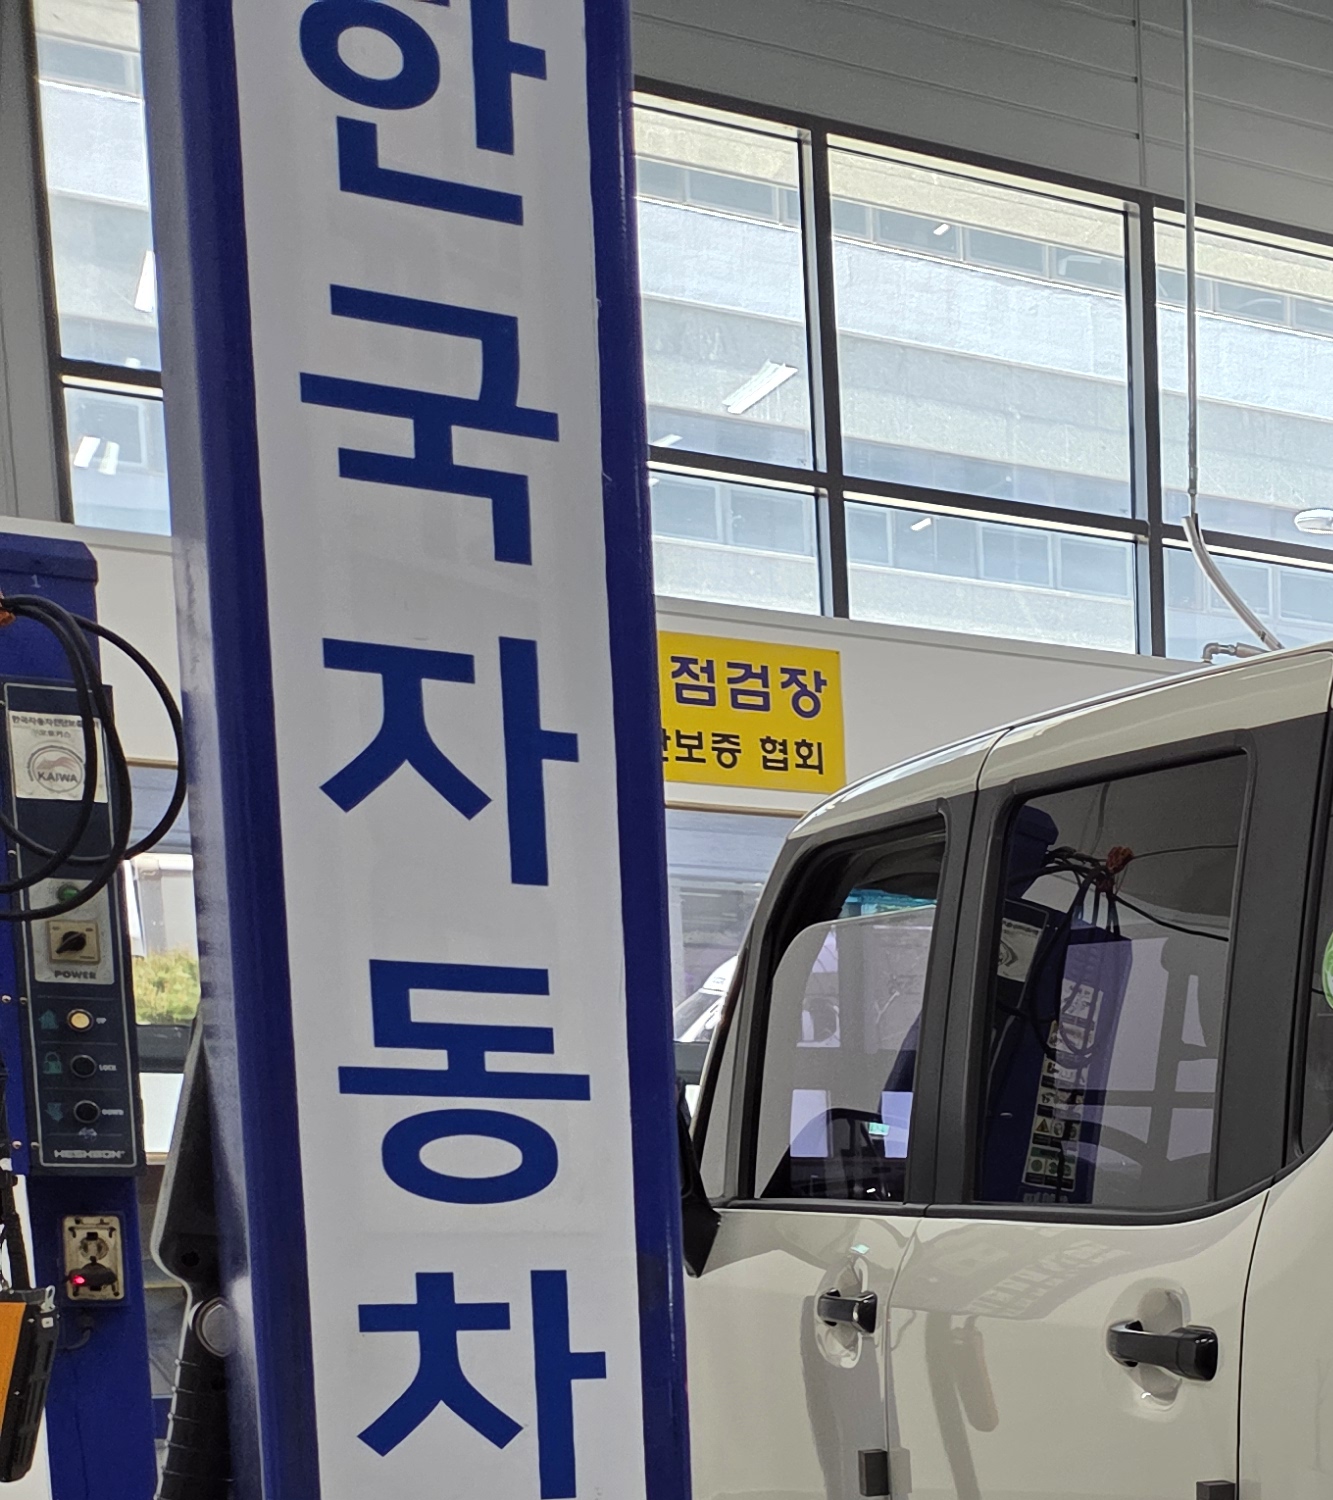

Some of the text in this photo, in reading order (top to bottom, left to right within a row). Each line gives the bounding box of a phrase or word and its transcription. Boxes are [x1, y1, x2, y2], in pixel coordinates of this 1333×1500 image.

[669, 655, 828, 719] 점검장
[759, 735, 824, 775] 협회
[37, 771, 78, 783] KAIWA
[54, 970, 97, 980] POWER
